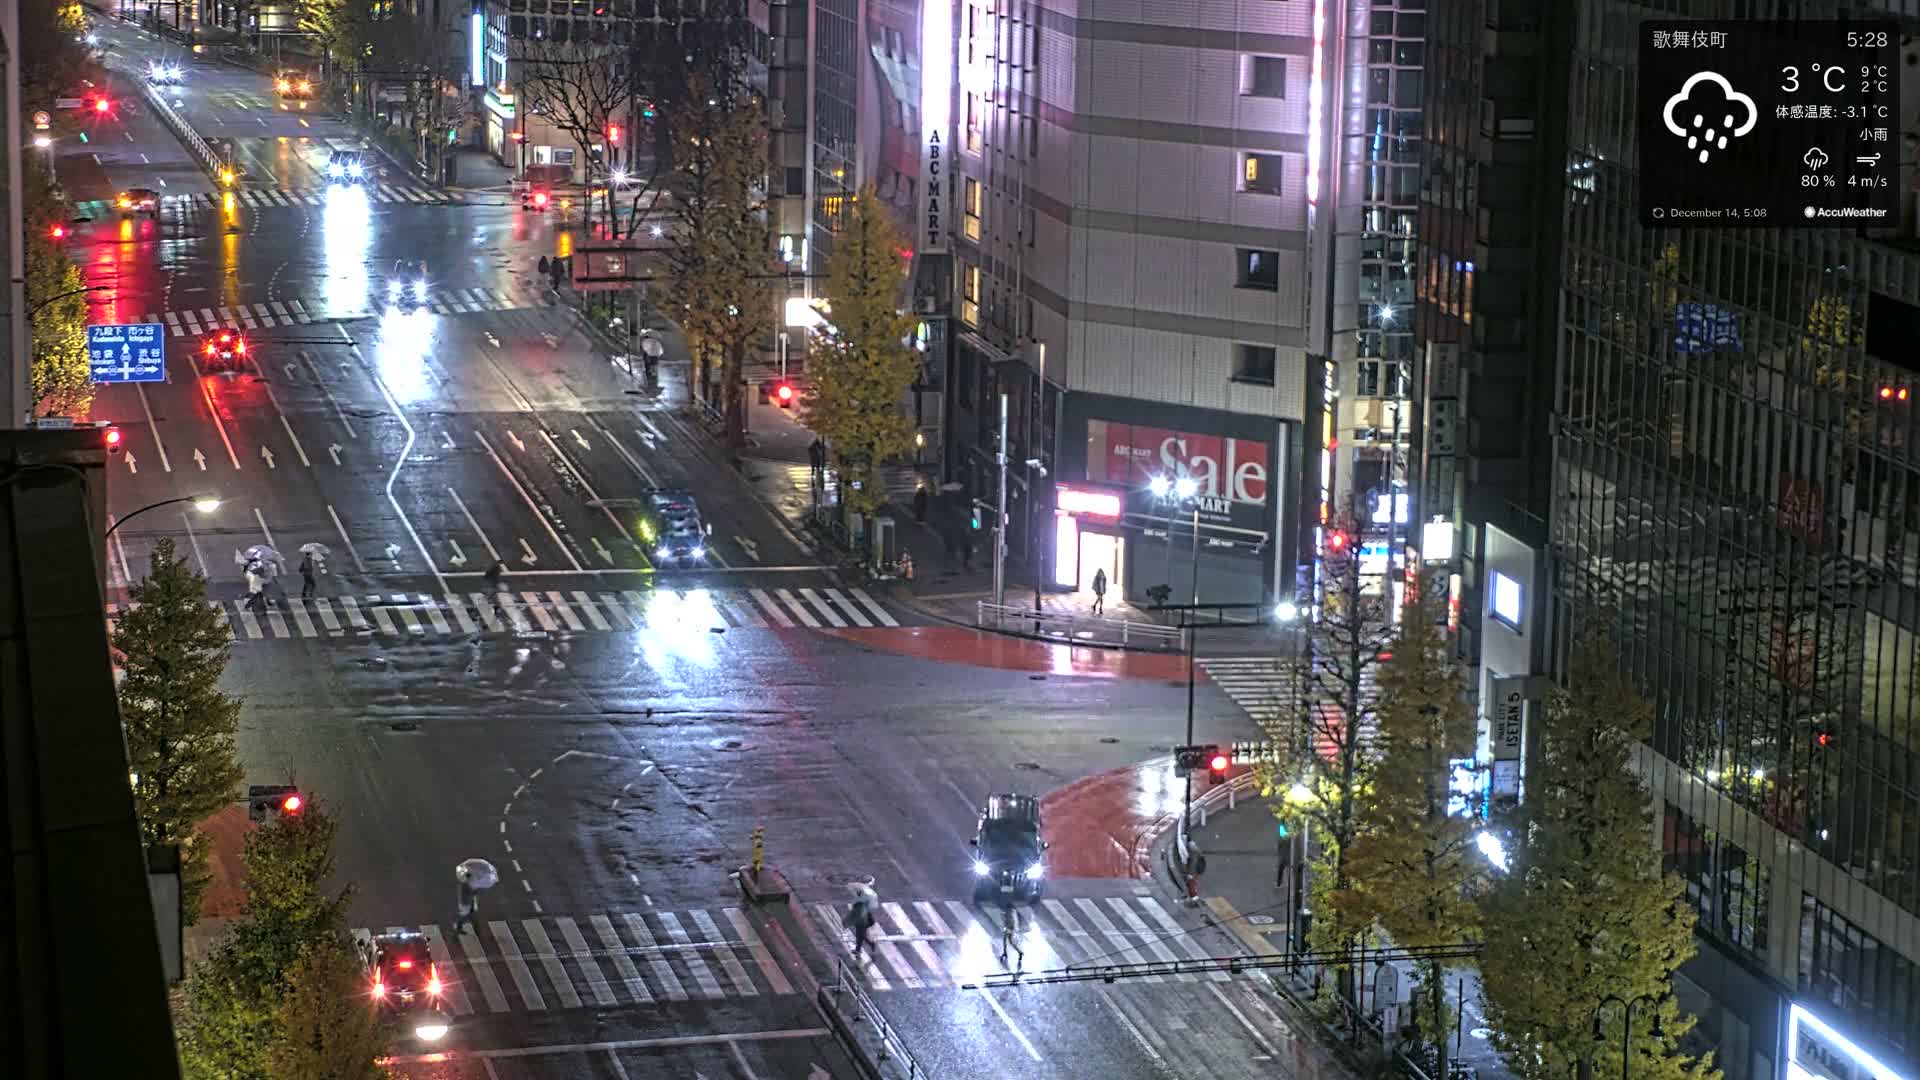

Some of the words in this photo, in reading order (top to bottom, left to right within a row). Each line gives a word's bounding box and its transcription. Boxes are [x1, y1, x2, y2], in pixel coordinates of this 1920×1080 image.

[95, 327, 123, 336] 九段下
[1159, 437, 1267, 504] Sale
[1507, 692, 1520, 702] 5
[1506, 706, 1520, 747] ISETAN
